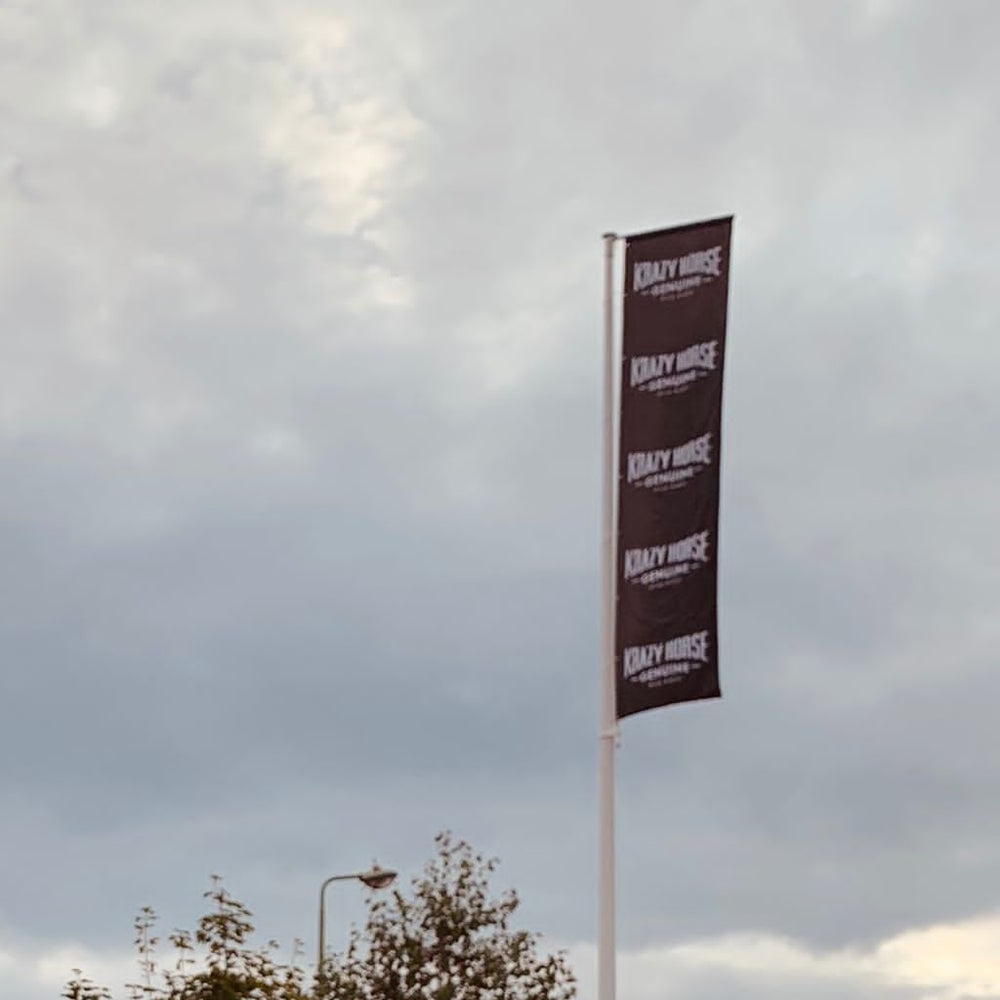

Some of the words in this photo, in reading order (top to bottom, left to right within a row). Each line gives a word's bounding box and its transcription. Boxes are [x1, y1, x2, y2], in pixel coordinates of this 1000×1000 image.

[633, 259, 679, 292] KRAZY
[679, 246, 722, 276] HORSE
[631, 353, 675, 387] KRAZY
[676, 341, 718, 370] HORSE
[627, 449, 671, 483] KRAZY
[672, 432, 711, 467] HORSE
[624, 544, 667, 580] KRAZY
[667, 530, 709, 563] HORSE
[623, 642, 664, 679] KRAZY
[664, 629, 708, 663] HORSE
